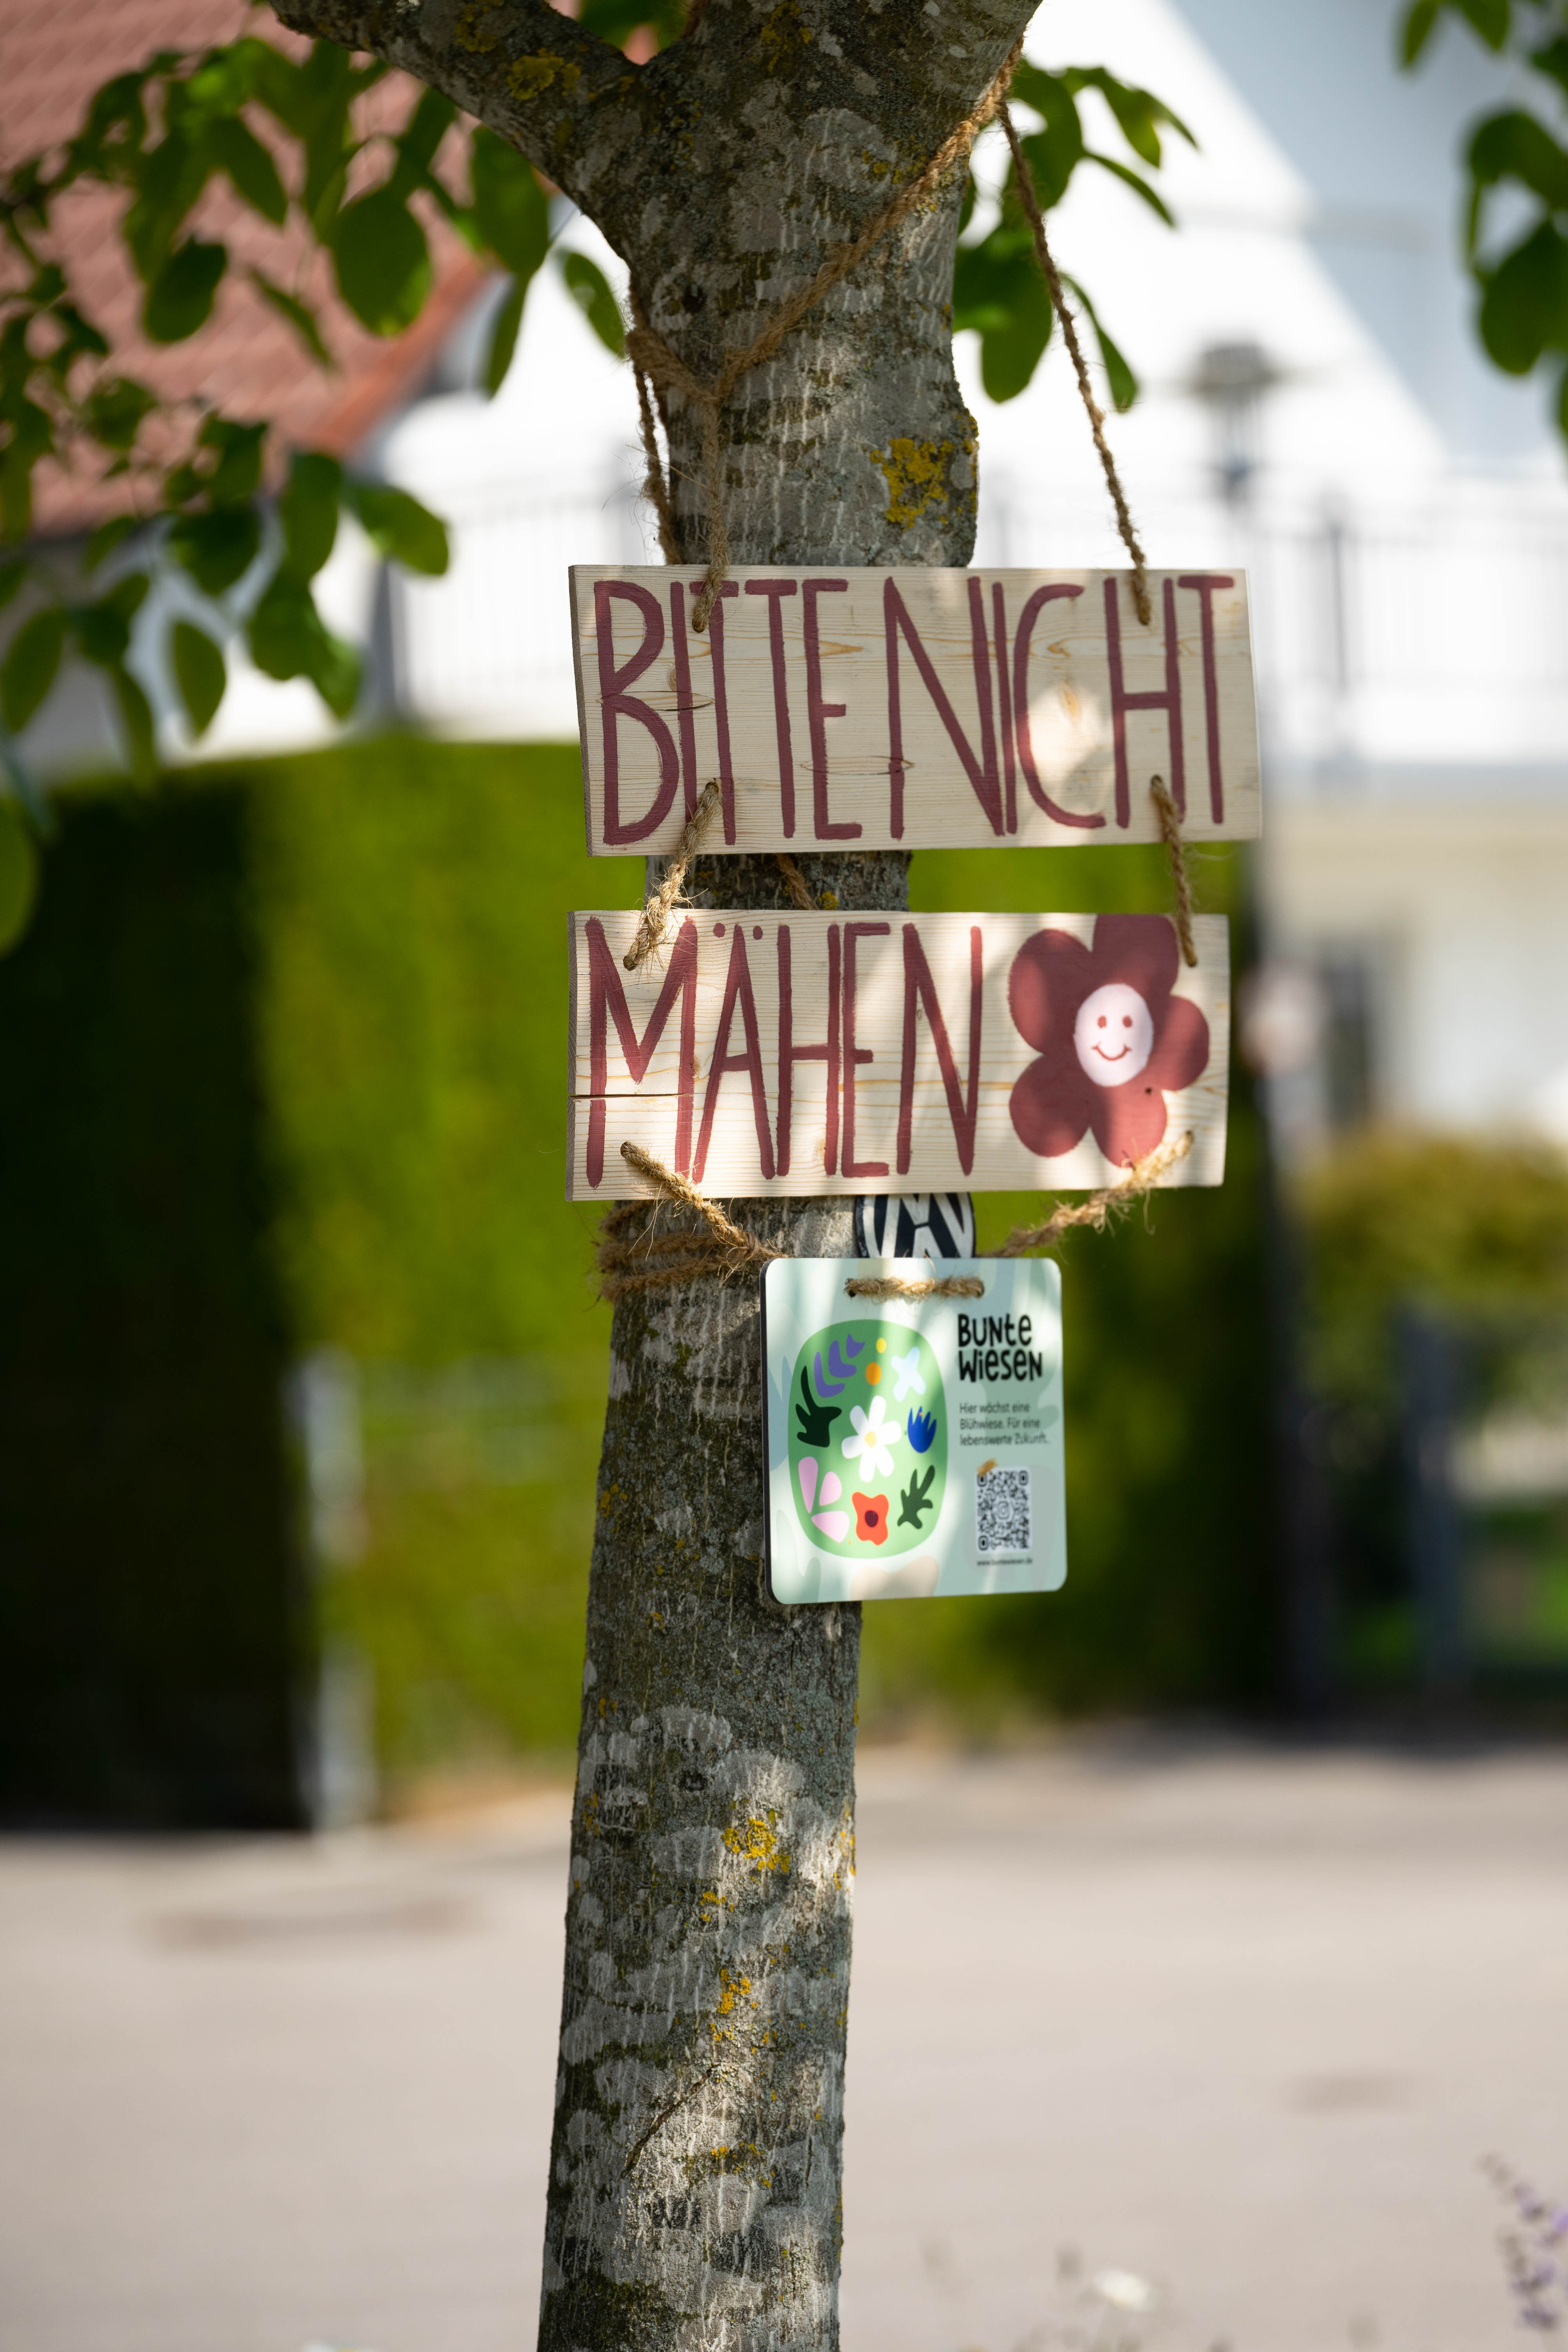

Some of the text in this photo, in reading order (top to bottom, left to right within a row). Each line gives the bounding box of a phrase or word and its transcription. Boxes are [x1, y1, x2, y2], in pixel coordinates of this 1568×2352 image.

[594, 576, 1234, 846] BITTE NICHT
[584, 915, 983, 1189] MÄHEN
[959, 1401, 1029, 1413] Hier wächst eine
[1007, 1417, 1020, 1428] Für
[1023, 1417, 1040, 1429] eine
[960, 1434, 1012, 1446] lebenswerte
